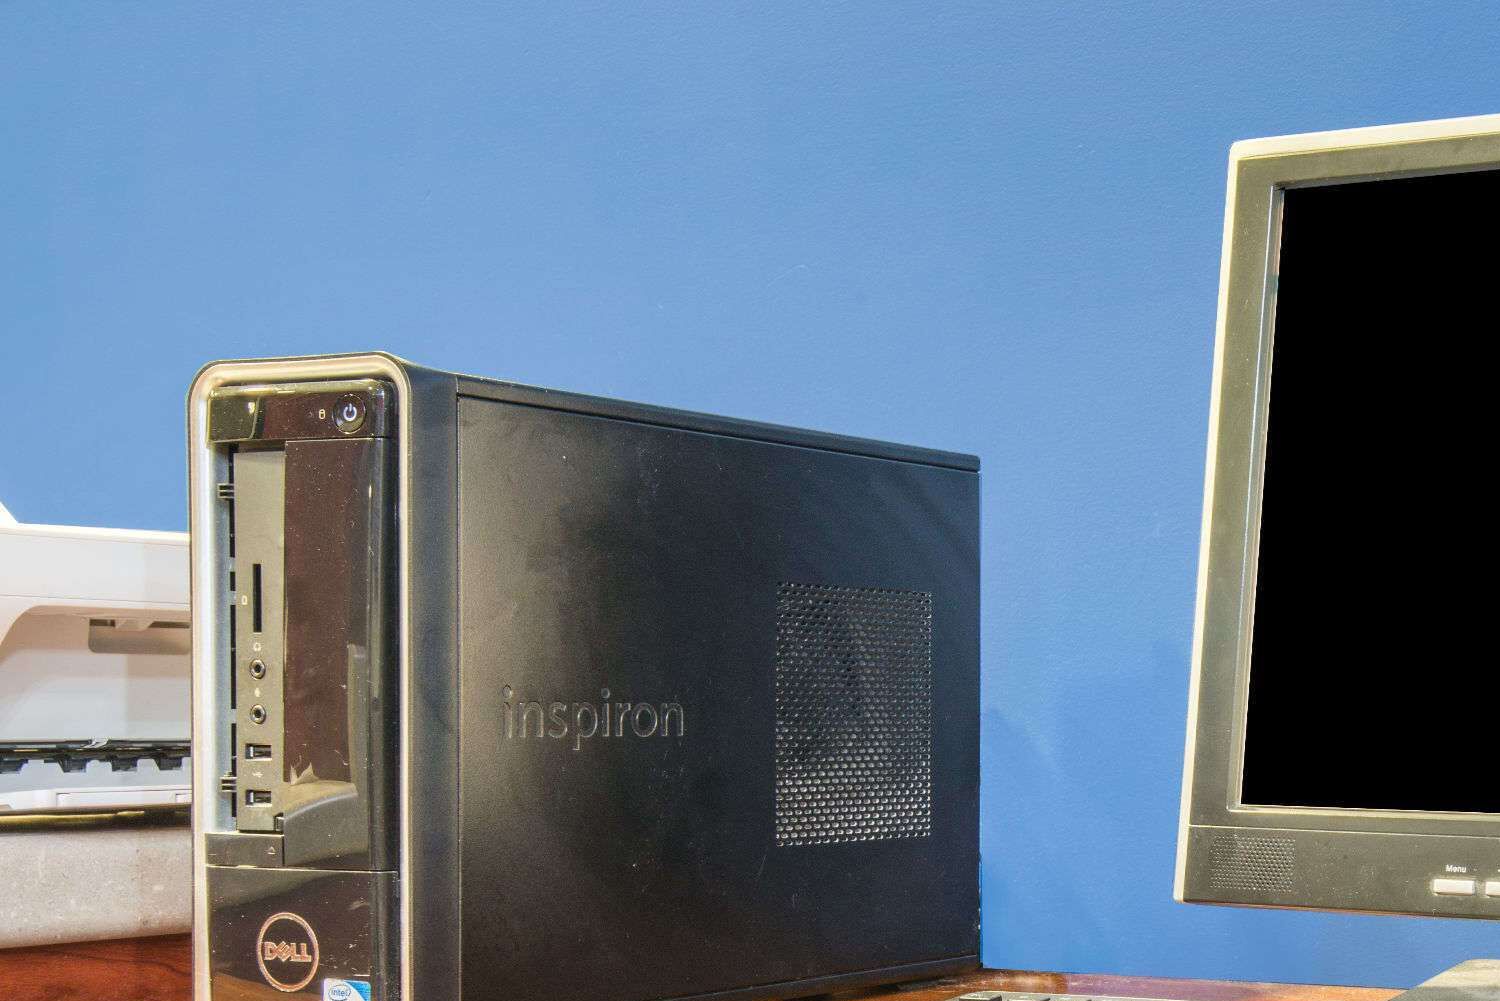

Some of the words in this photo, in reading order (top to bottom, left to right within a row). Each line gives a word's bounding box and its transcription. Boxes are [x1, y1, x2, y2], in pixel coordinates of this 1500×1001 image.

[502, 684, 685, 751] inspiron
[1446, 864, 1467, 874] Menu
[264, 941, 312, 962] DELL
